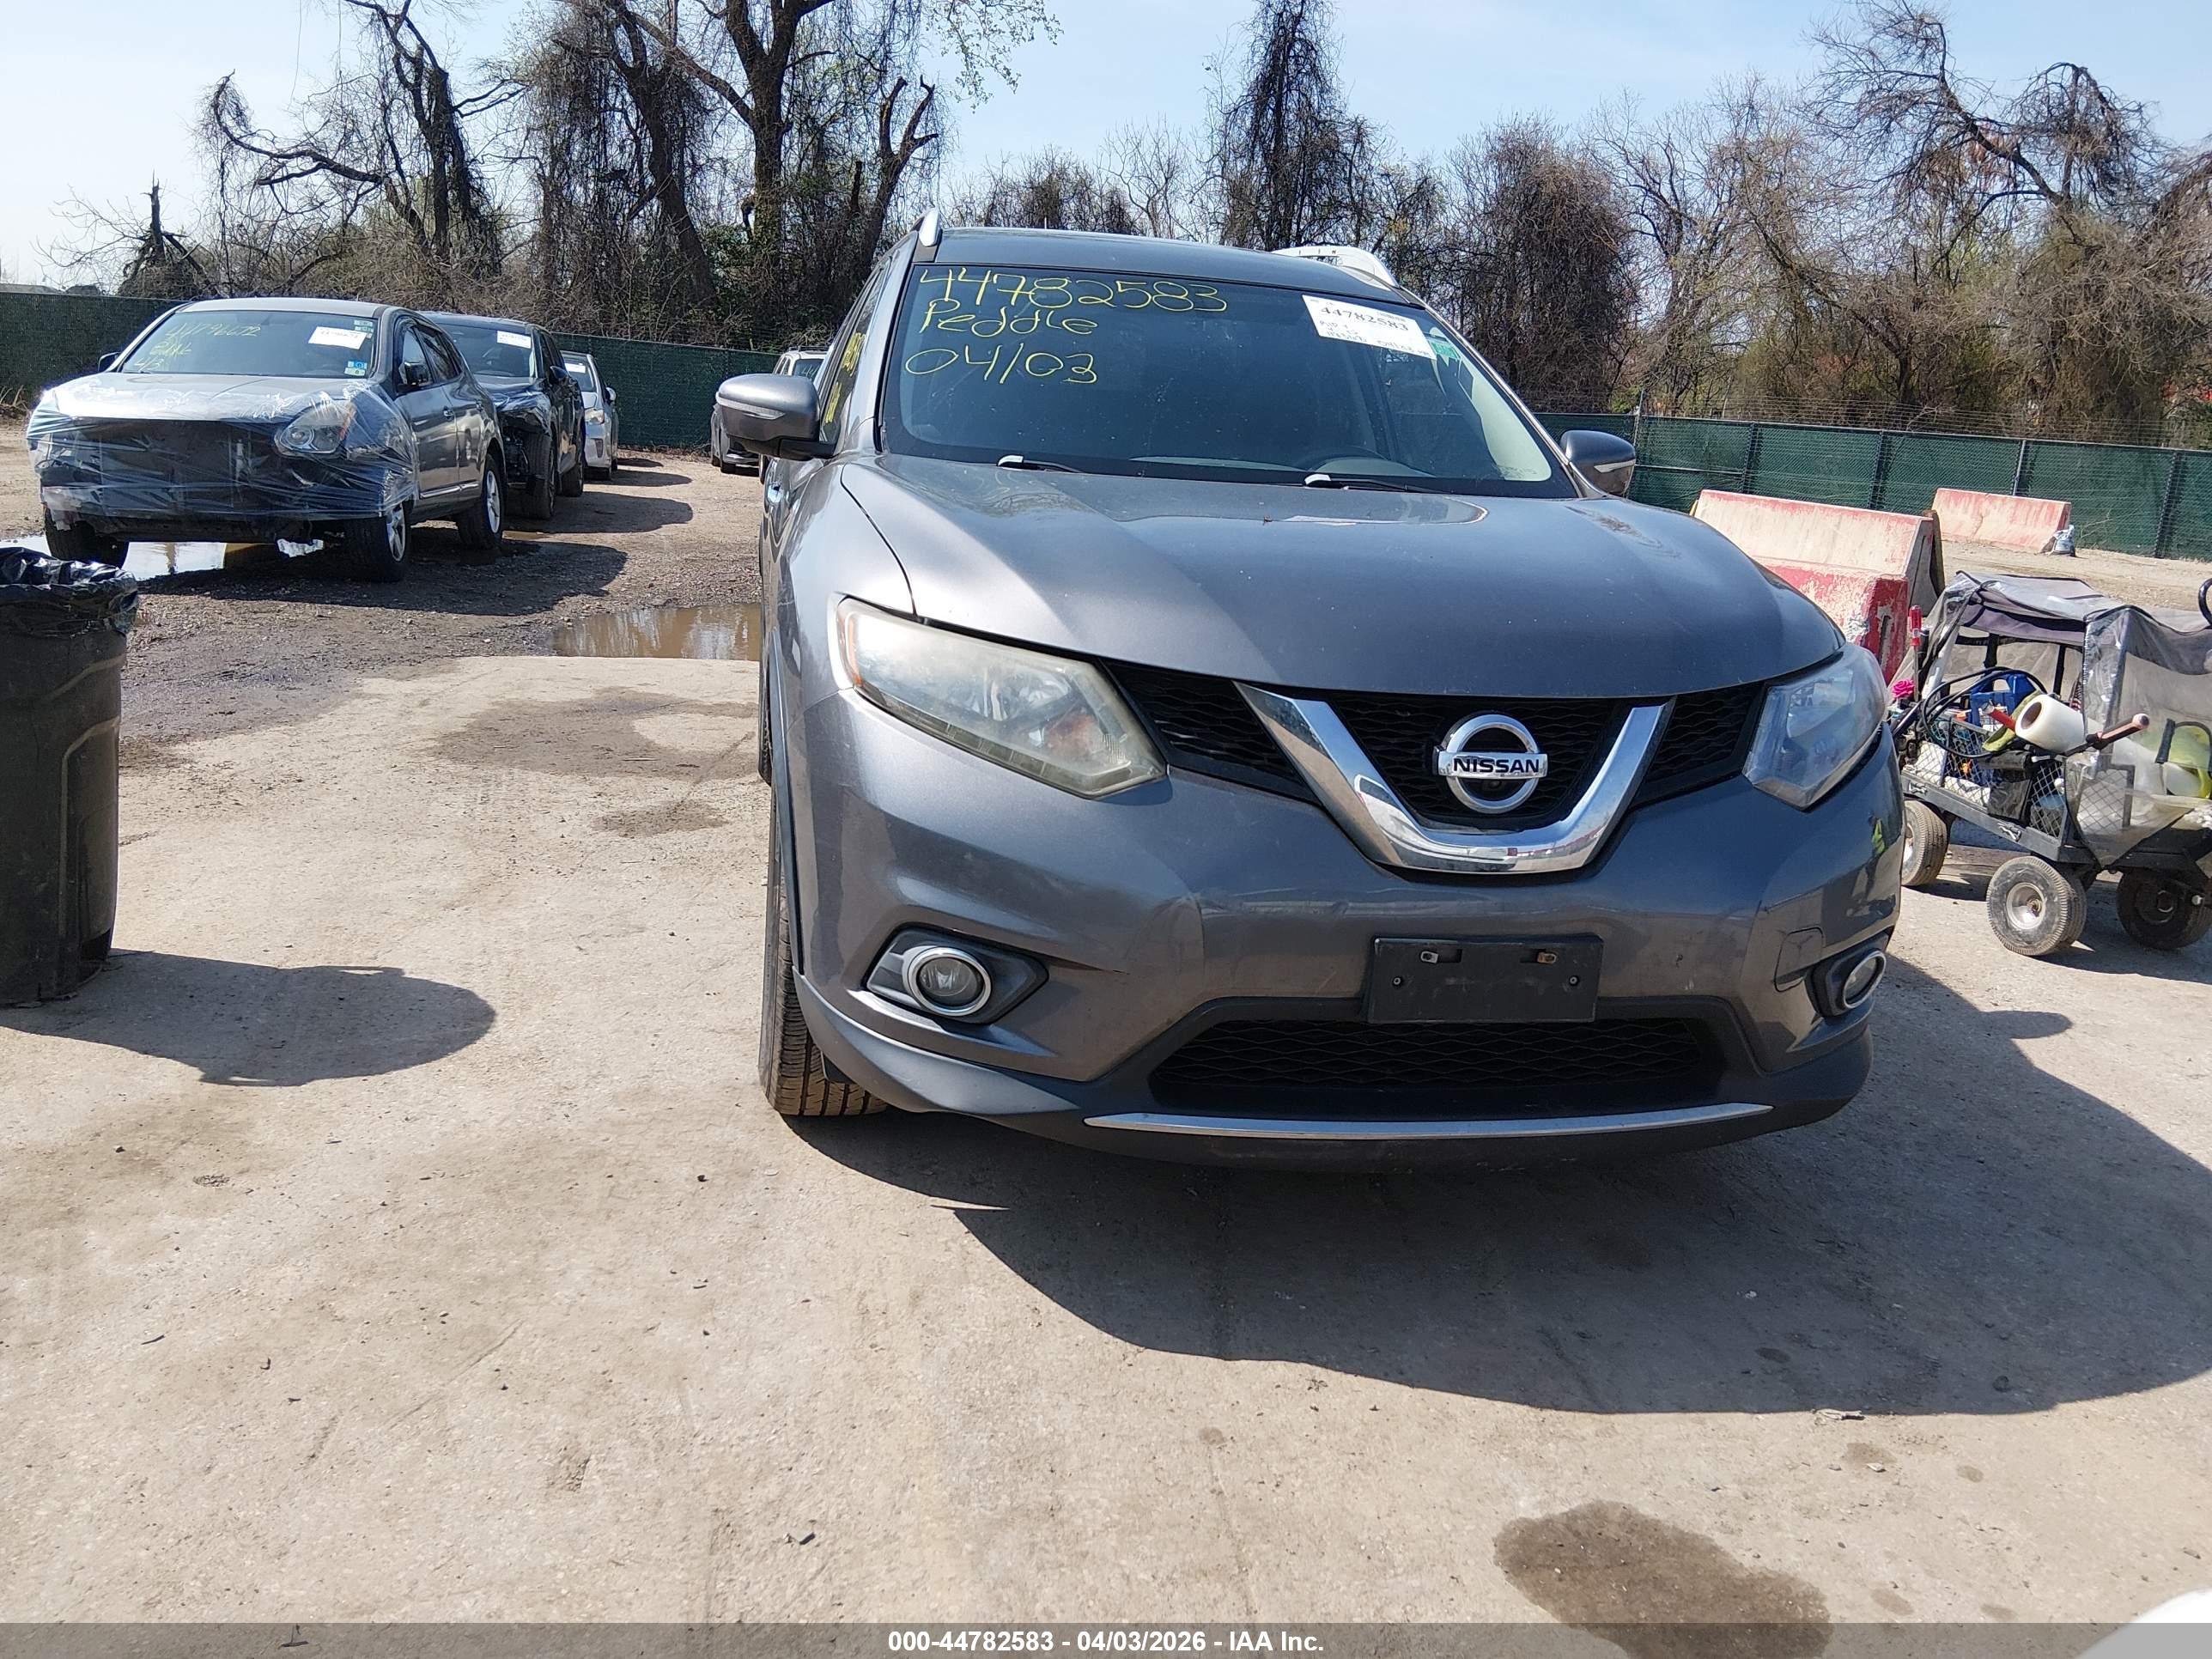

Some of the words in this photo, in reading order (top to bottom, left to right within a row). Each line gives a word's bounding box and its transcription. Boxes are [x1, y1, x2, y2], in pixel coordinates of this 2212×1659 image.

[920, 267, 1227, 312] 44782583
[919, 298, 1098, 337] Peddle
[1321, 306, 1409, 331] 44782583
[905, 343, 1097, 384] 04/03
[1453, 758, 1540, 774] NISSAN
